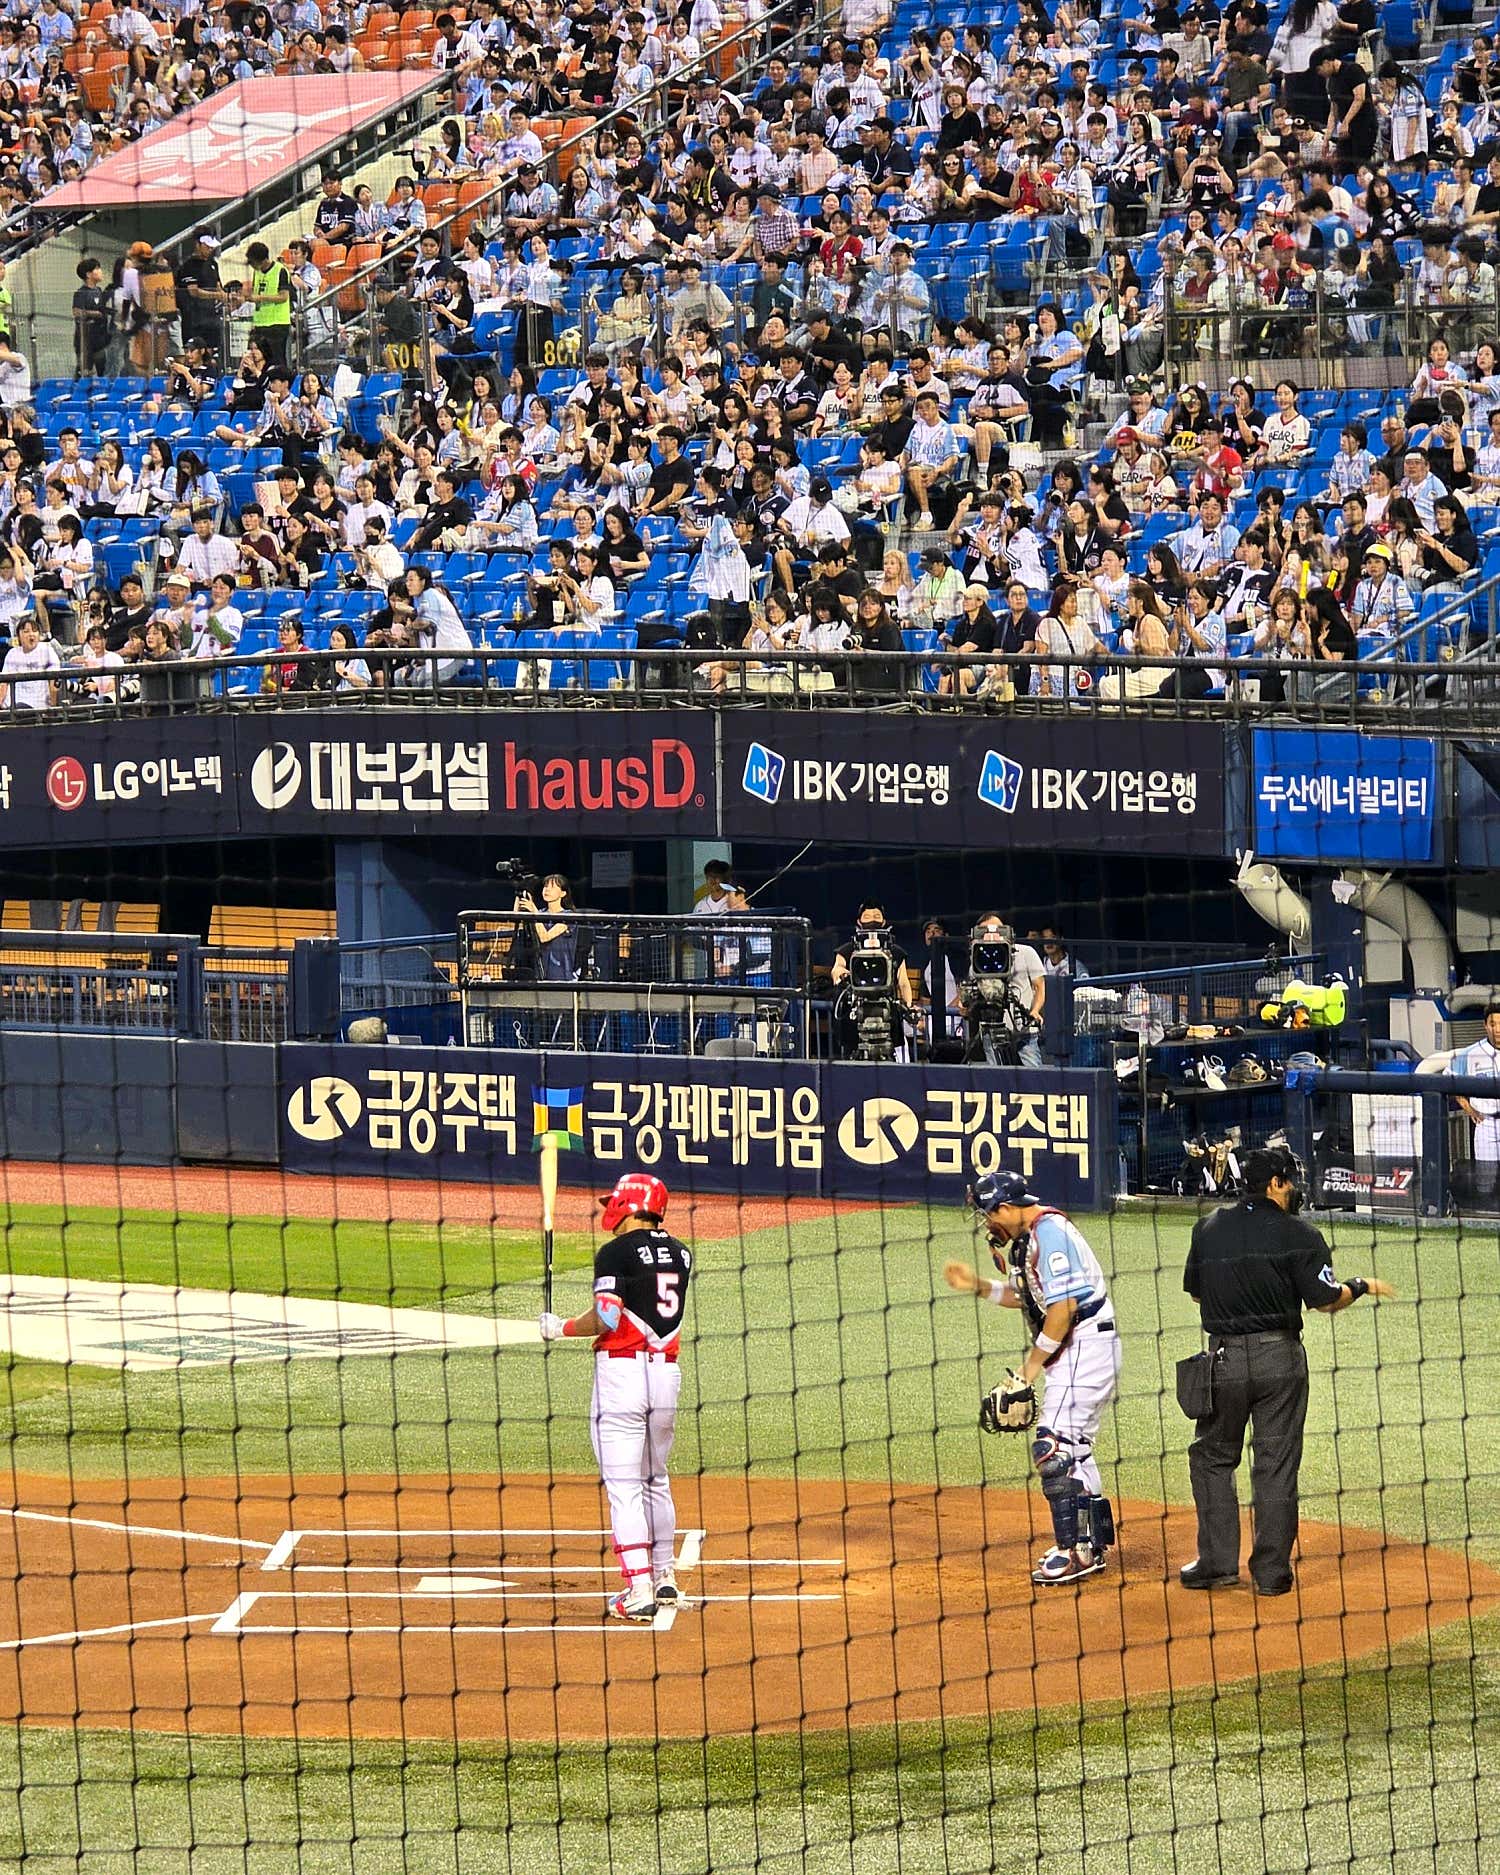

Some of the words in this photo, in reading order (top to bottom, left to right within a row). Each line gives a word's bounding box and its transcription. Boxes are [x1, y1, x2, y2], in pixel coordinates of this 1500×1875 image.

[93, 755, 222, 801] LG이노텍
[310, 741, 490, 811] 대보건설
[1258, 774, 1428, 816] 두산에너빌리티
[366, 1069, 517, 1156] 금강주택
[587, 1079, 825, 1169] 금강펜테리움
[924, 1090, 1090, 1179] 금강주택
[656, 1272, 679, 1319] 5
